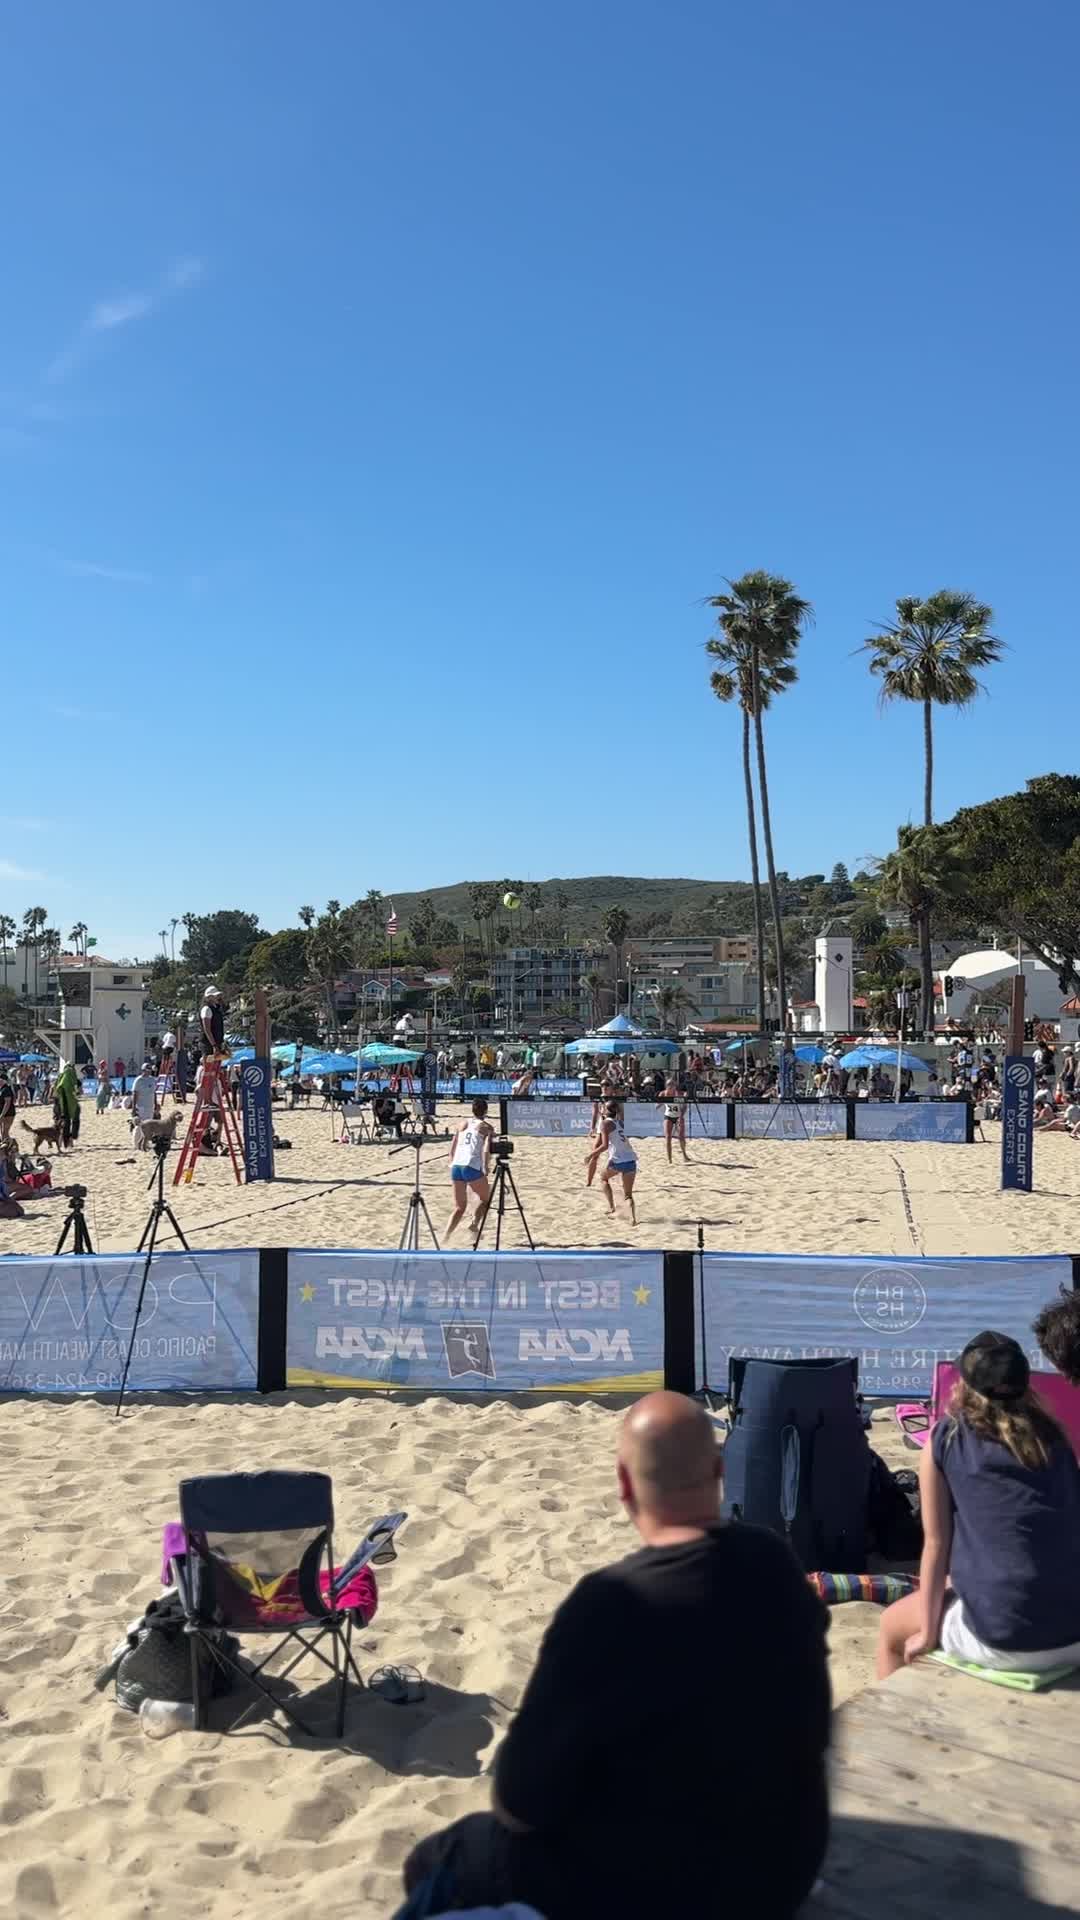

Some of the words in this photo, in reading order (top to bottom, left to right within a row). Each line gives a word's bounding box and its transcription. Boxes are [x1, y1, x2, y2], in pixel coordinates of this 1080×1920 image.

[247, 1090, 257, 1137] COURT
[257, 1106, 267, 1158] EXPERTS
[1017, 1089, 1029, 1129] SAND
[248, 1142, 259, 1177] SAND
[465, 1131, 473, 1145] 9
[1006, 1108, 1016, 1165] EXPERTS
[1016, 1133, 1027, 1185] COURT
